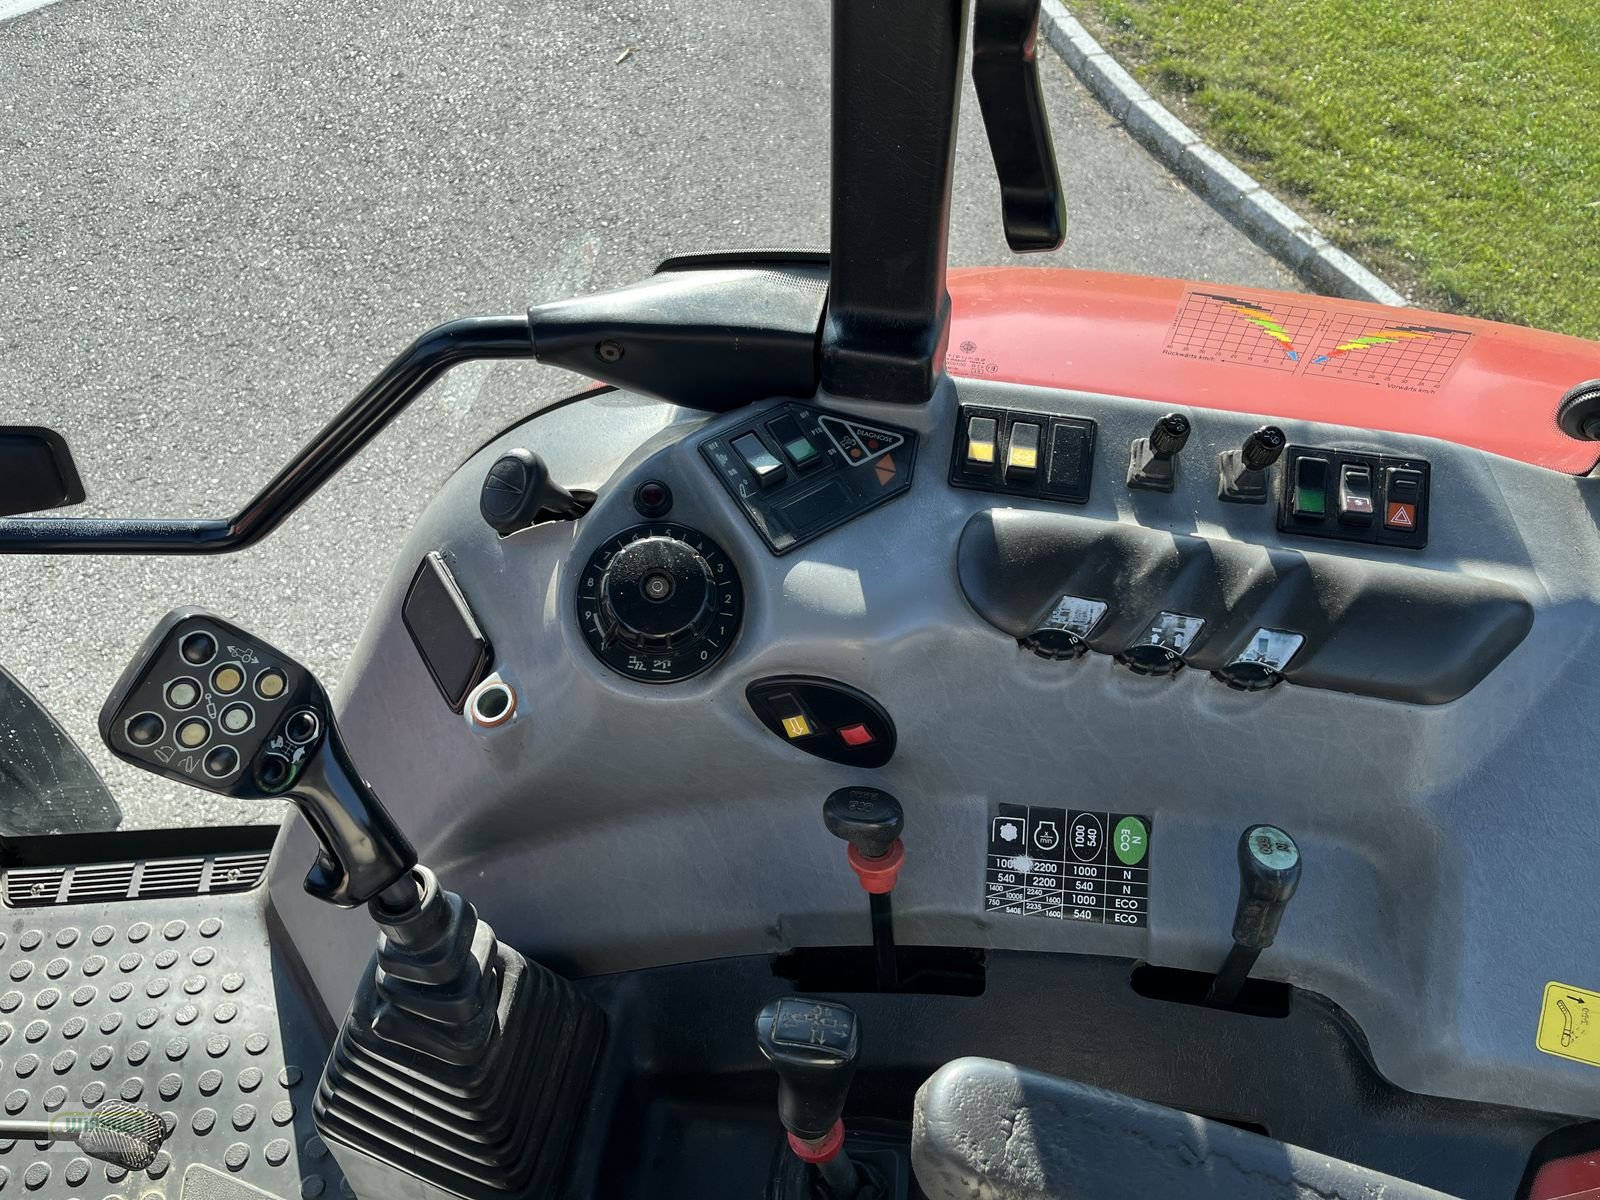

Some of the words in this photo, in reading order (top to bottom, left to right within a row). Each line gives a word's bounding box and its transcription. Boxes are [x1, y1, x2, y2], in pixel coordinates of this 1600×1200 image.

[1162, 349, 1198, 360] Rückwärts
[1387, 383, 1417, 392] Vorwärts
[856, 428, 893, 443] DIAGNOSE
[665, 529, 672, 537] 5
[603, 551, 610, 560] 7
[717, 563, 724, 573] 3
[587, 577, 594, 587] 8
[724, 593, 732, 604] 2
[585, 610, 592, 620] 9
[720, 626, 725, 635] 1
[1068, 636, 1079, 645] 10
[700, 650, 708, 660] 0
[1164, 651, 1175, 661] 10
[1075, 825, 1086, 848] 1000
[1087, 828, 1098, 847] 540
[1120, 828, 1131, 852] ECO
[1034, 862, 1057, 873] 2200
[1073, 866, 1097, 877] 1000
[1123, 870, 1132, 880] N
[997, 873, 1015, 883] 540
[1032, 876, 1056, 887] 2200
[1075, 881, 1093, 891] 540
[1123, 885, 1131, 894] N
[989, 884, 1004, 892] 1400
[1026, 888, 1043, 896] 2240
[1072, 894, 1096, 905] 1000
[1115, 898, 1138, 909] ECO
[1046, 895, 1061, 904] 1600
[988, 898, 1000, 906] 750
[1026, 902, 1042, 910] 2235
[1073, 909, 1092, 920] 540
[1114, 913, 1138, 924] ECO
[1006, 906, 1022, 914] 540E
[1045, 910, 1061, 918] 1600
